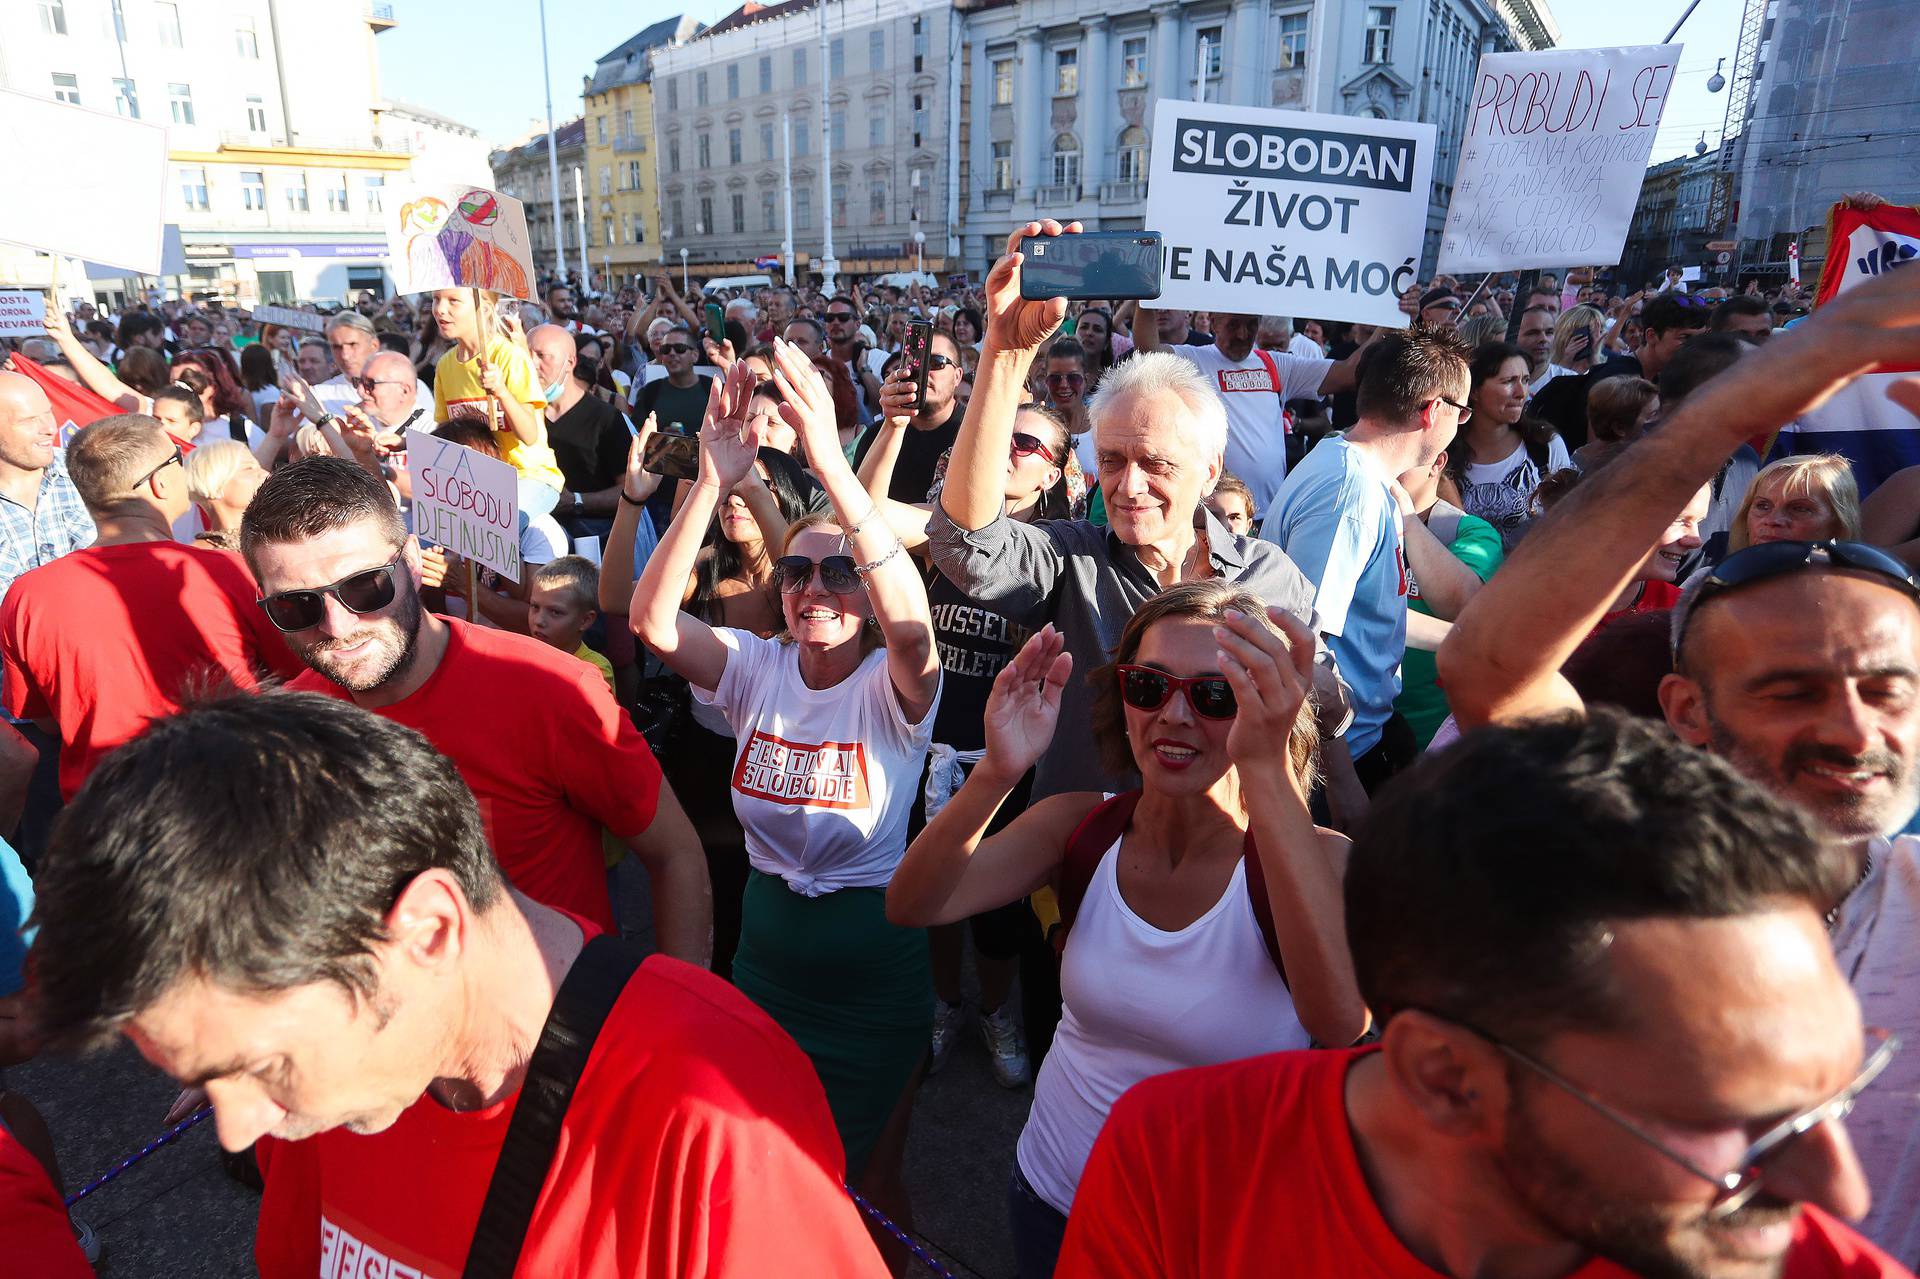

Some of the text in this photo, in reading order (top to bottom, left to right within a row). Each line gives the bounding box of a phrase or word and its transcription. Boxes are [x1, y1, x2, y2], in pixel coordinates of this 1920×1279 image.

[1471, 65, 1675, 136] PROBUDI SE!
[1180, 128, 1407, 183] SLOBODAN
[1483, 136, 1567, 170] TOTALNA
[1474, 166, 1609, 199] PLANDEMIJA
[1224, 179, 1360, 234] ŽIVOT
[1460, 231, 1497, 258] NE
[1500, 223, 1597, 256] GENOCID
[1204, 244, 1315, 289] NAŠA
[1324, 257, 1416, 299] MOĆ
[0, 296, 30, 305] OSTA
[0, 308, 32, 317] ORONA
[433, 441, 476, 486] ZA
[421, 468, 512, 529] SLOBODU
[417, 501, 519, 579] DJETINJSTVA
[742, 765, 854, 800] SLOBODE
